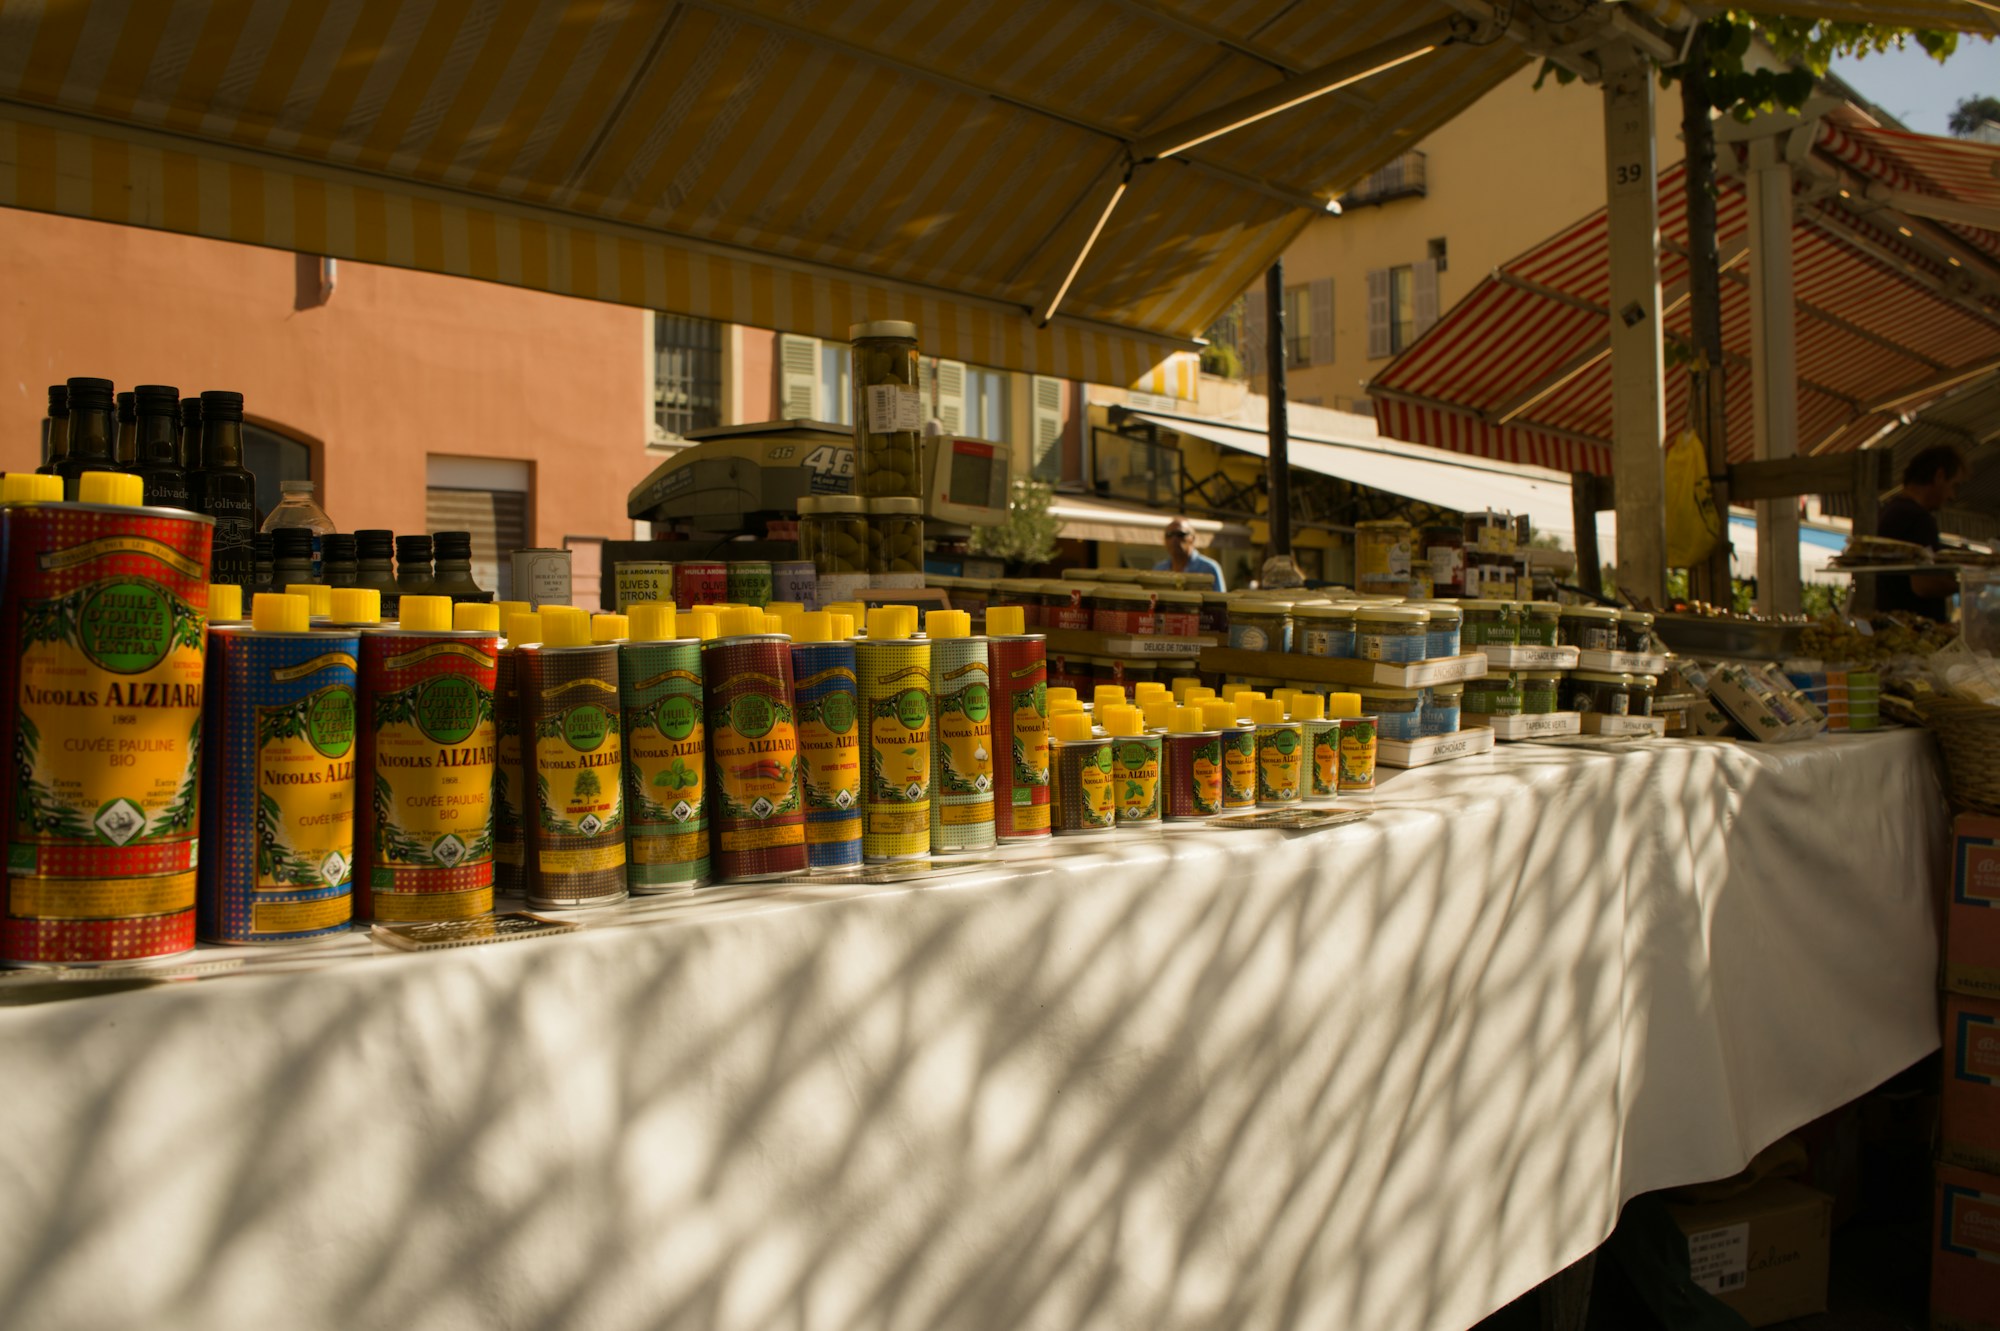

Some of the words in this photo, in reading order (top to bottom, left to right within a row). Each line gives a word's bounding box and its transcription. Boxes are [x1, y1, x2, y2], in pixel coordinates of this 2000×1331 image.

[1616, 164, 1641, 185] 39
[769, 447, 795, 459] 46
[801, 445, 855, 478] 46
[204, 498, 252, 510] L'olivade
[620, 580, 650, 589] OLIVES
[652, 580, 658, 589] &
[729, 579, 758, 588] OLIVES
[620, 592, 657, 600] CITRONS
[101, 594, 157, 610] HUILE
[88, 608, 163, 625] D'OLIVE
[90, 624, 162, 641] VIERGE
[94, 639, 158, 655] EXTRA
[1144, 643, 1166, 651] DELICE
[1167, 643, 1175, 651] DE
[1525, 652, 1550, 660] TAPENADE
[25, 685, 99, 707] NICOLAS
[431, 687, 468, 697] HUILE
[422, 698, 473, 709] D'OLIVE
[427, 708, 473, 719] VIERGE
[573, 713, 600, 723] HUILE
[663, 709, 691, 720] HUILE
[112, 715, 136, 725] 1868
[429, 719, 471, 731] EXTRA
[1526, 721, 1552, 731] TAPENADE
[1552, 720, 1567, 729] VERTE
[568, 723, 604, 733] D'OLIVE
[1016, 724, 1040, 733] NICOLAS
[875, 735, 907, 744] NICOLAS
[943, 730, 973, 739] NICOLAS
[64, 736, 115, 752] CUVÉE
[119, 739, 175, 752] PAULINE
[801, 740, 834, 750] NICOLAS
[1433, 741, 1467, 756] ANCHOÏADE
[633, 747, 669, 759] NICOLAS
[715, 747, 746, 757] NICOLAS
[110, 754, 136, 766] BIO
[379, 752, 432, 768] NICOLAS
[540, 758, 576, 769] NICOLAS
[264, 769, 321, 785] NICOLAS
[745, 781, 776, 792] Piment
[406, 794, 443, 807] CUVÉE
[447, 793, 484, 806] PAULINE
[440, 809, 458, 820] BIO
[566, 805, 597, 814] DIAMANT
[300, 814, 331, 826] CUVÉE
